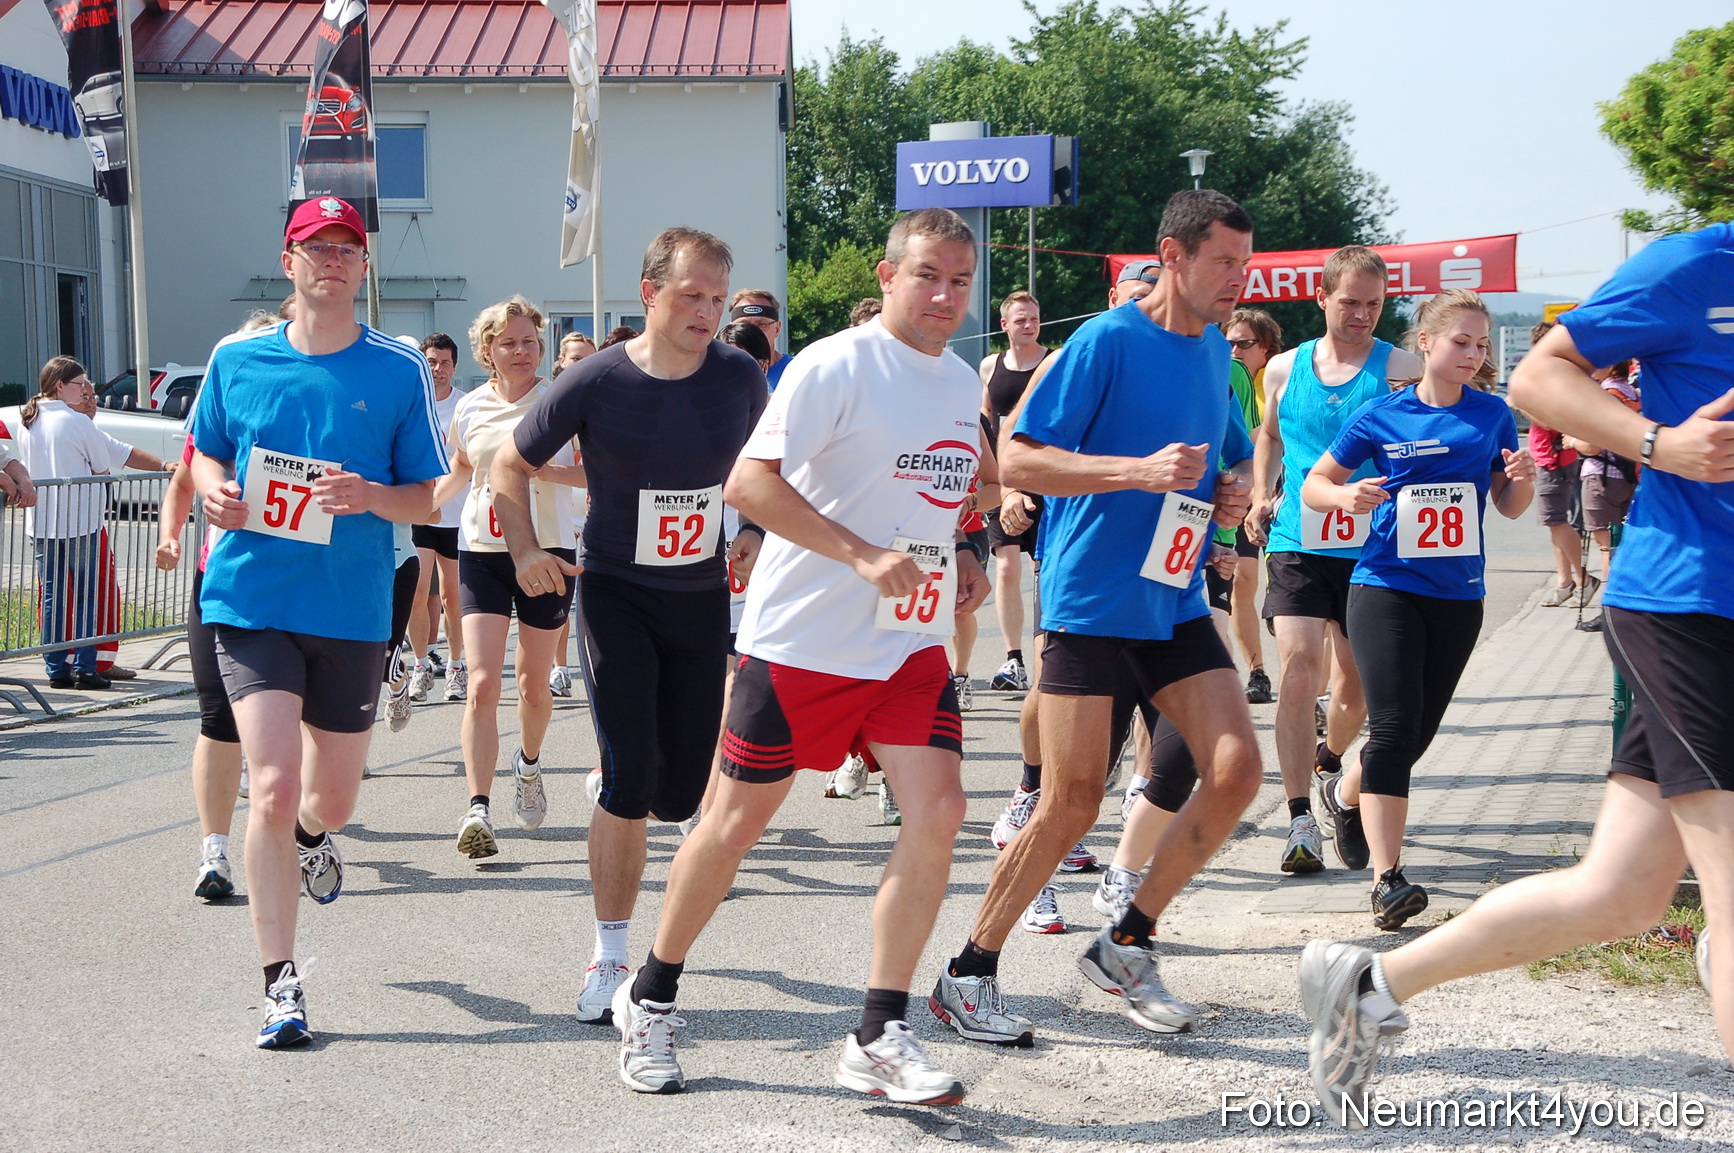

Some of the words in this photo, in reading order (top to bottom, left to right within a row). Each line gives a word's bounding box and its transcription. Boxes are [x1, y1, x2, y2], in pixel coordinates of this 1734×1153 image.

[910, 157, 1030, 186] VOLVO
[1243, 266, 1324, 299] ART
[1385, 262, 1426, 293] EL
[263, 464, 304, 479] WERBUNG
[264, 455, 304, 471] MEYER
[896, 453, 972, 474] GERHART
[654, 494, 695, 504] MEYER
[1410, 487, 1447, 498] MEYER
[1410, 496, 1448, 504] WERBUNG
[263, 479, 313, 531] 57
[653, 503, 694, 511] WERBUNG
[1321, 509, 1355, 541] 75
[1417, 506, 1464, 548] 28
[657, 513, 705, 558] 52
[907, 543, 940, 556] MEYER
